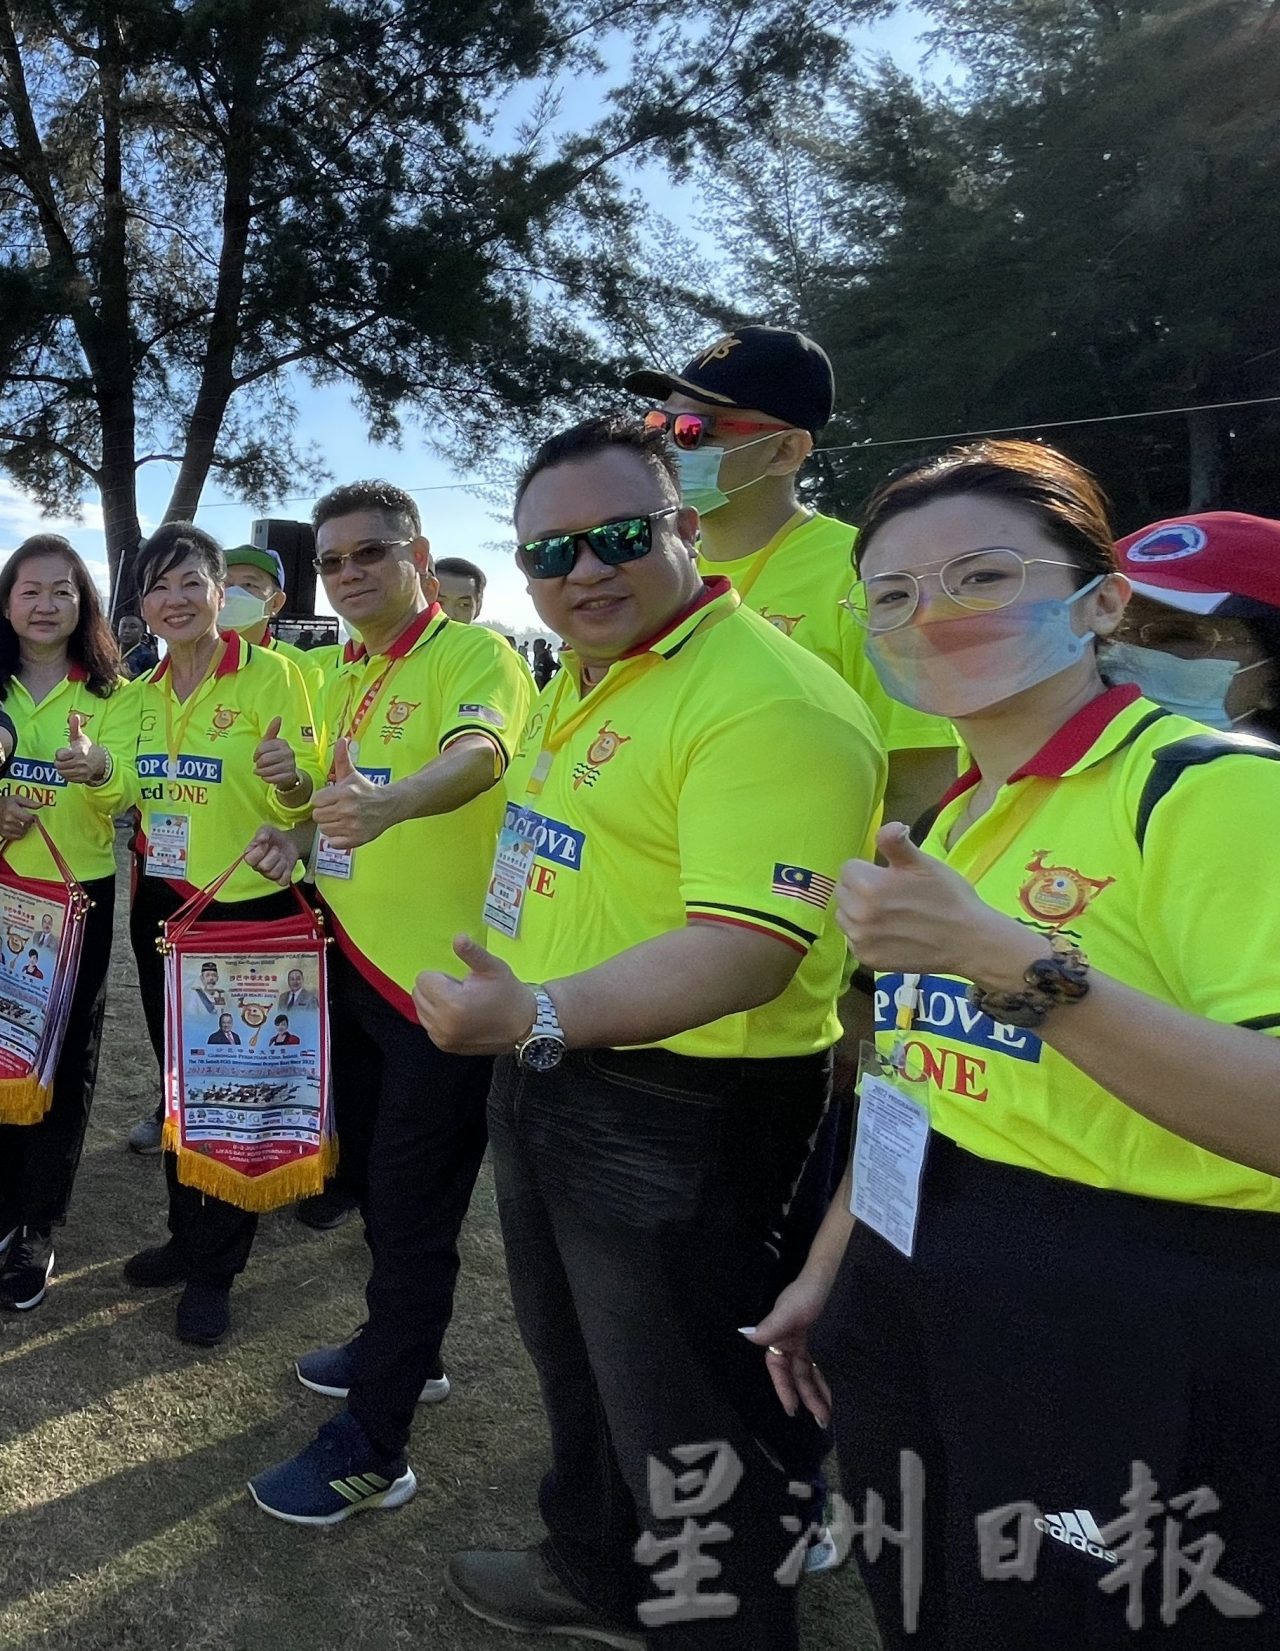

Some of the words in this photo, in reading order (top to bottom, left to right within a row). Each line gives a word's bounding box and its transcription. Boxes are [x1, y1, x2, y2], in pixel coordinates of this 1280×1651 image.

[10, 762, 65, 783] GLOVE
[136, 760, 159, 775] OP
[141, 783, 163, 799] red
[169, 783, 208, 804] ONE
[899, 1041, 989, 1102] ONE
[1034, 1518, 1118, 1564] adidas
